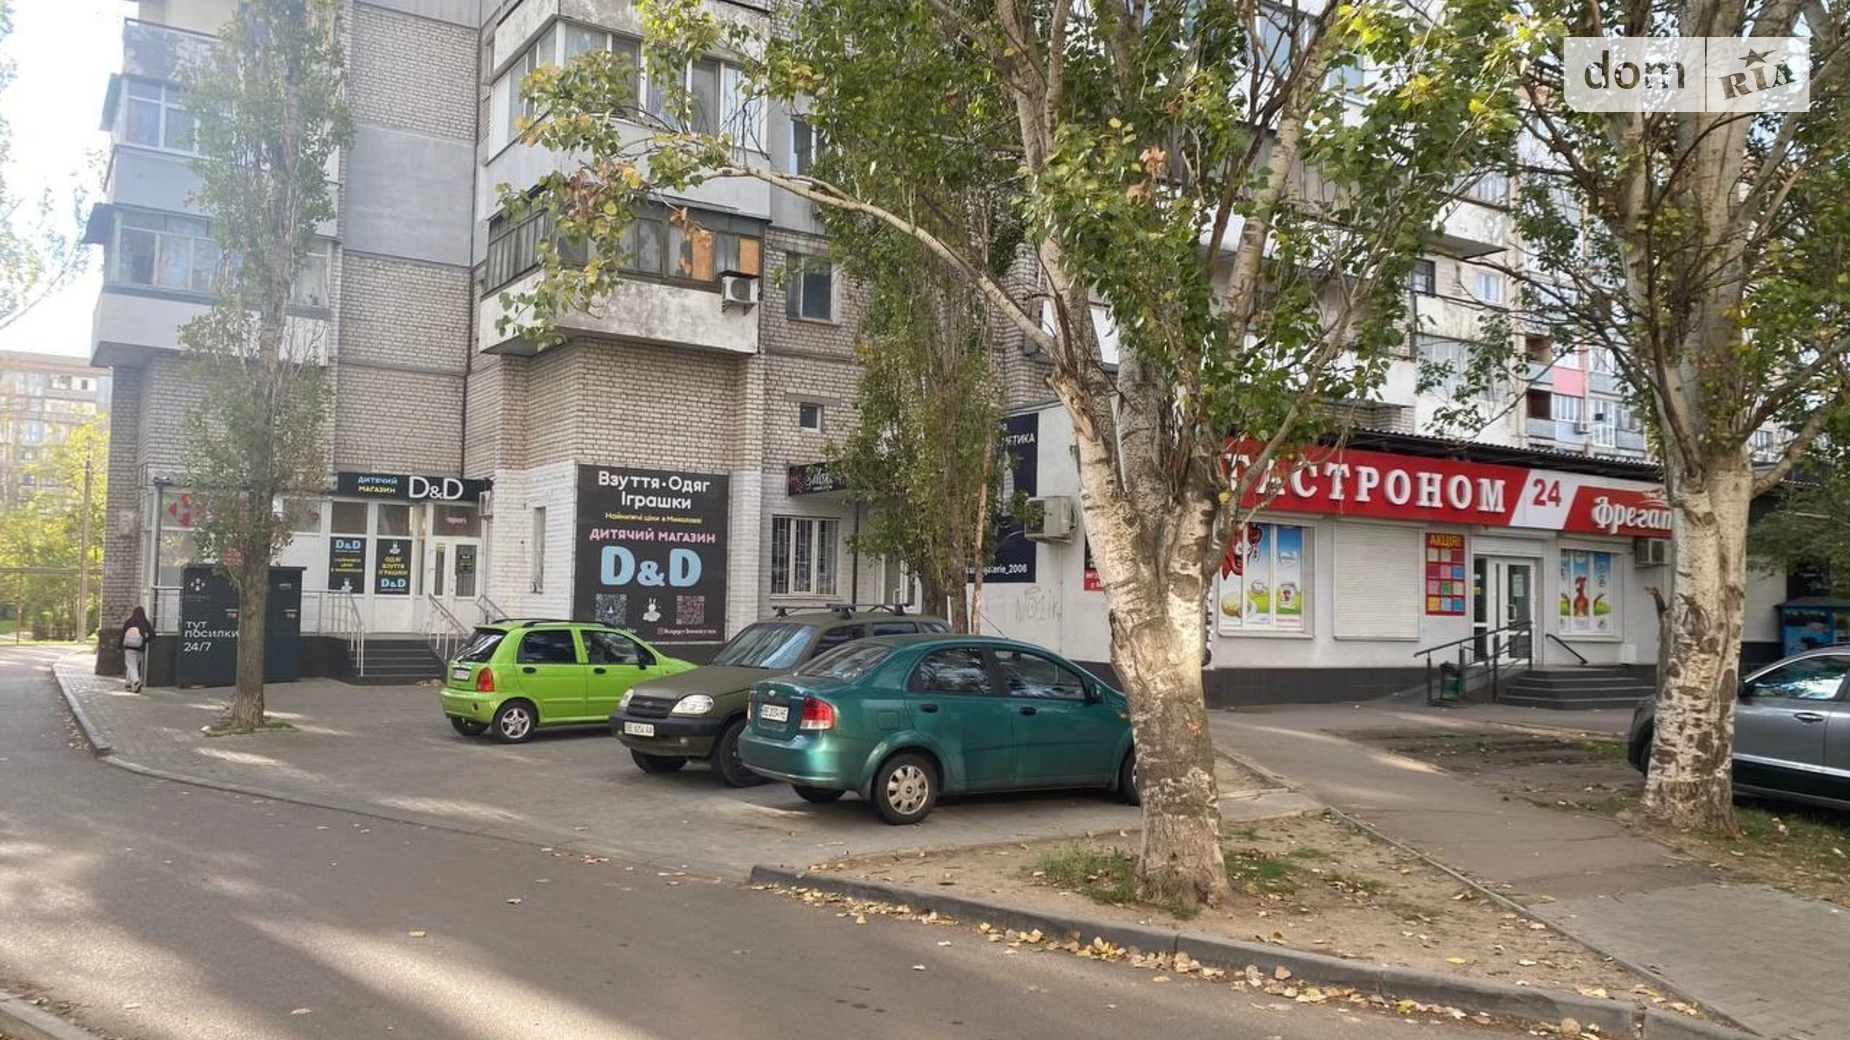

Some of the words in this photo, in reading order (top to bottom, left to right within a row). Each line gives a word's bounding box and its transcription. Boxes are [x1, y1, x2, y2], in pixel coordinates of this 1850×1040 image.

[358, 486, 395, 494] МАГАЗИН
[408, 476, 463, 500] D&D
[598, 471, 660, 490] Взуття
[668, 476, 711, 493] Одяг
[621, 491, 691, 510] Іграшки
[1533, 478, 1561, 507] 24
[589, 528, 655, 541] ДИТЯЧИЙ
[658, 532, 716, 544] МАГАЗИН
[601, 545, 702, 587] D&D
[184, 628, 240, 638] посилки
[184, 642, 212, 652] 24/7
